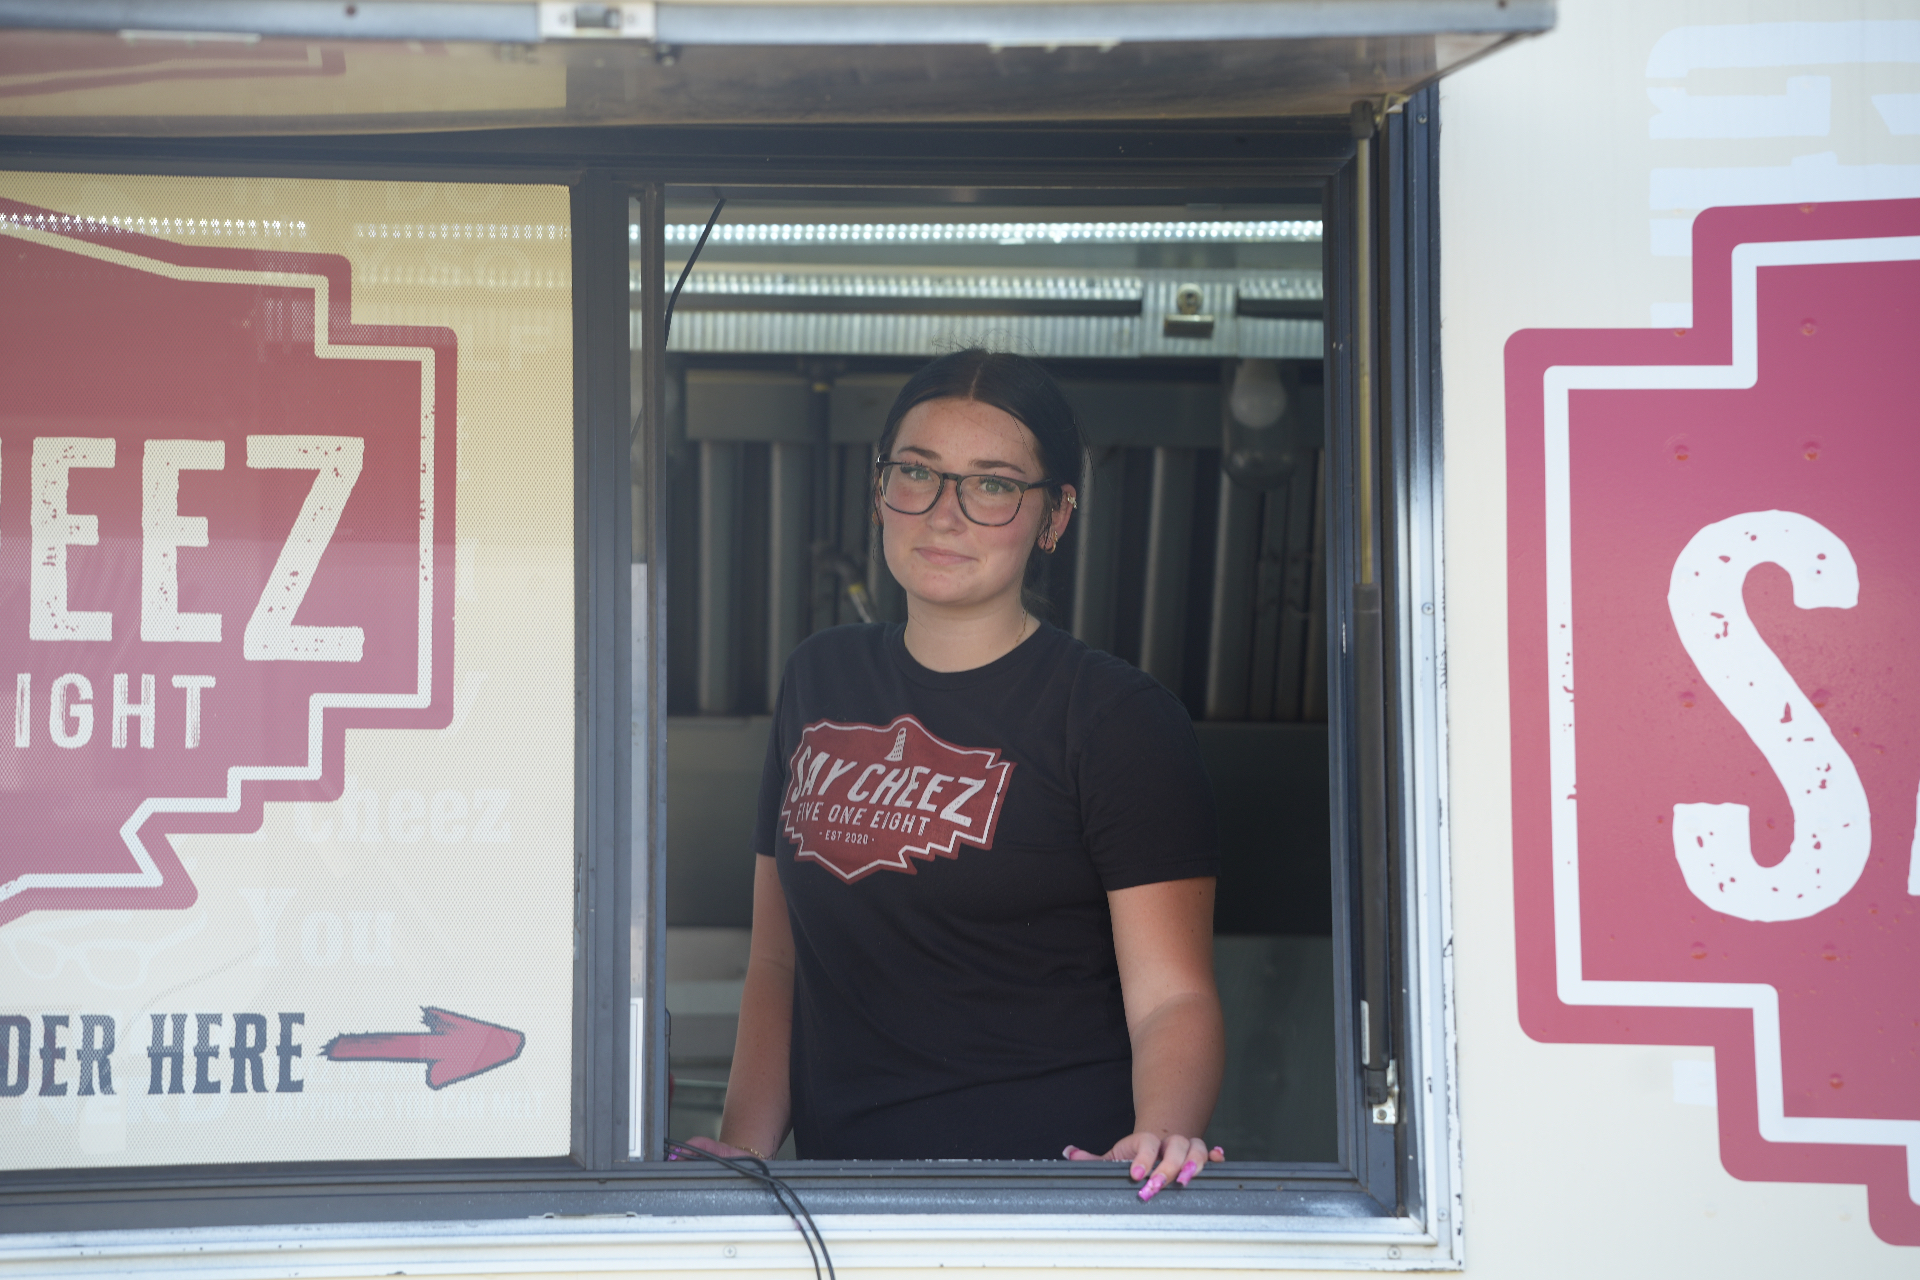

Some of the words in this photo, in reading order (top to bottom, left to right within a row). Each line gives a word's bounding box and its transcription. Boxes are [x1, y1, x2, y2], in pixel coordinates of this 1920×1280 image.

[0, 435, 365, 662] EEZ
[15, 673, 216, 748] IGHT
[791, 745, 858, 803] SAY
[847, 763, 987, 827] CHEEZ
[796, 802, 824, 823] FIVE
[828, 804, 867, 826] ONE
[869, 810, 931, 836] EIGHT
[825, 830, 842, 841] EST
[845, 832, 869, 845] 2020
[147, 1012, 305, 1095] HERE
